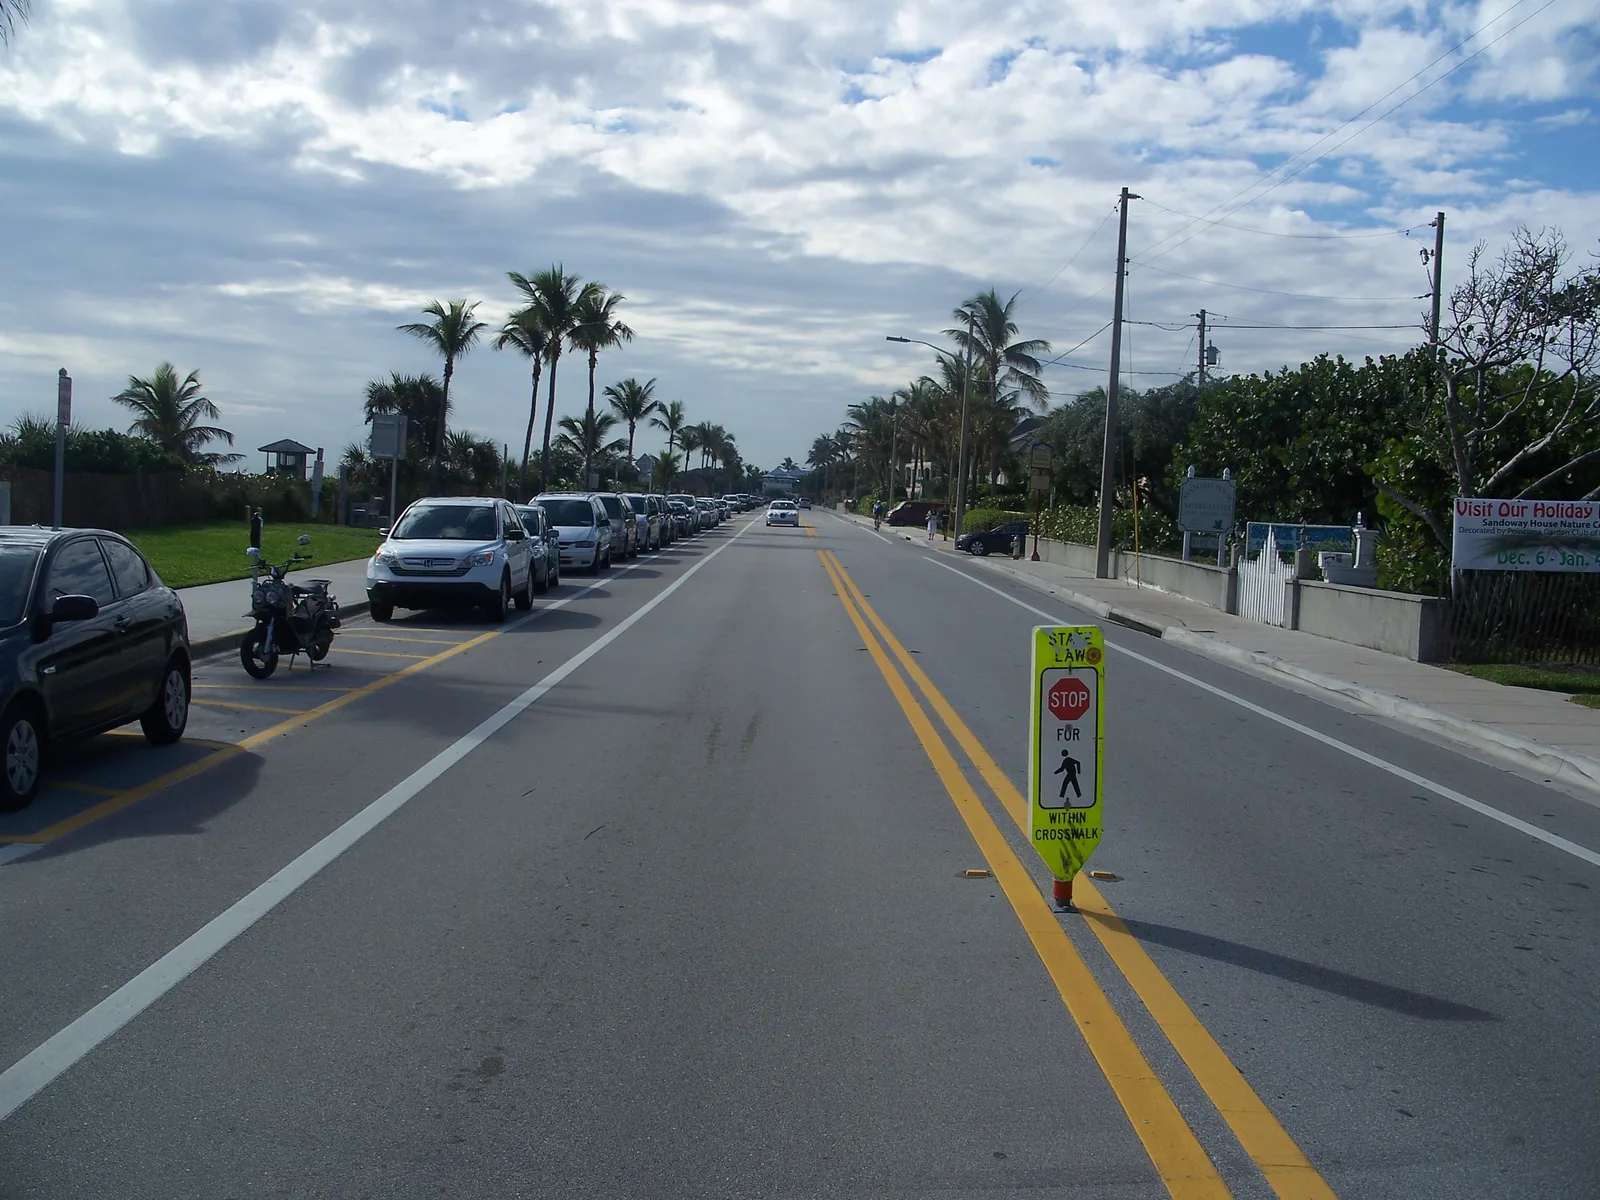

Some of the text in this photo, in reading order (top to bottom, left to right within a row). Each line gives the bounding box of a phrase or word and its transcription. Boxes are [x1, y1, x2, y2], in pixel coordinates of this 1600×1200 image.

[1456, 501, 1593, 519] Visit Our Holiday
[1482, 519, 1528, 529] Sandoway
[1530, 520, 1558, 528] House
[1560, 520, 1590, 529] Nature
[1459, 526, 1495, 534] Decorated
[1497, 527, 1505, 536] by
[1590, 529, 1599, 537] of
[1498, 551, 1530, 565] Dec.
[1536, 551, 1545, 565] 6
[1559, 551, 1589, 566] Jan.
[1055, 648, 1086, 662] LAW
[1050, 691, 1088, 708] STOP
[1057, 728, 1081, 742] FOR
[1049, 812, 1086, 824] WITHIN
[1035, 828, 1099, 840] CROSSWALK
